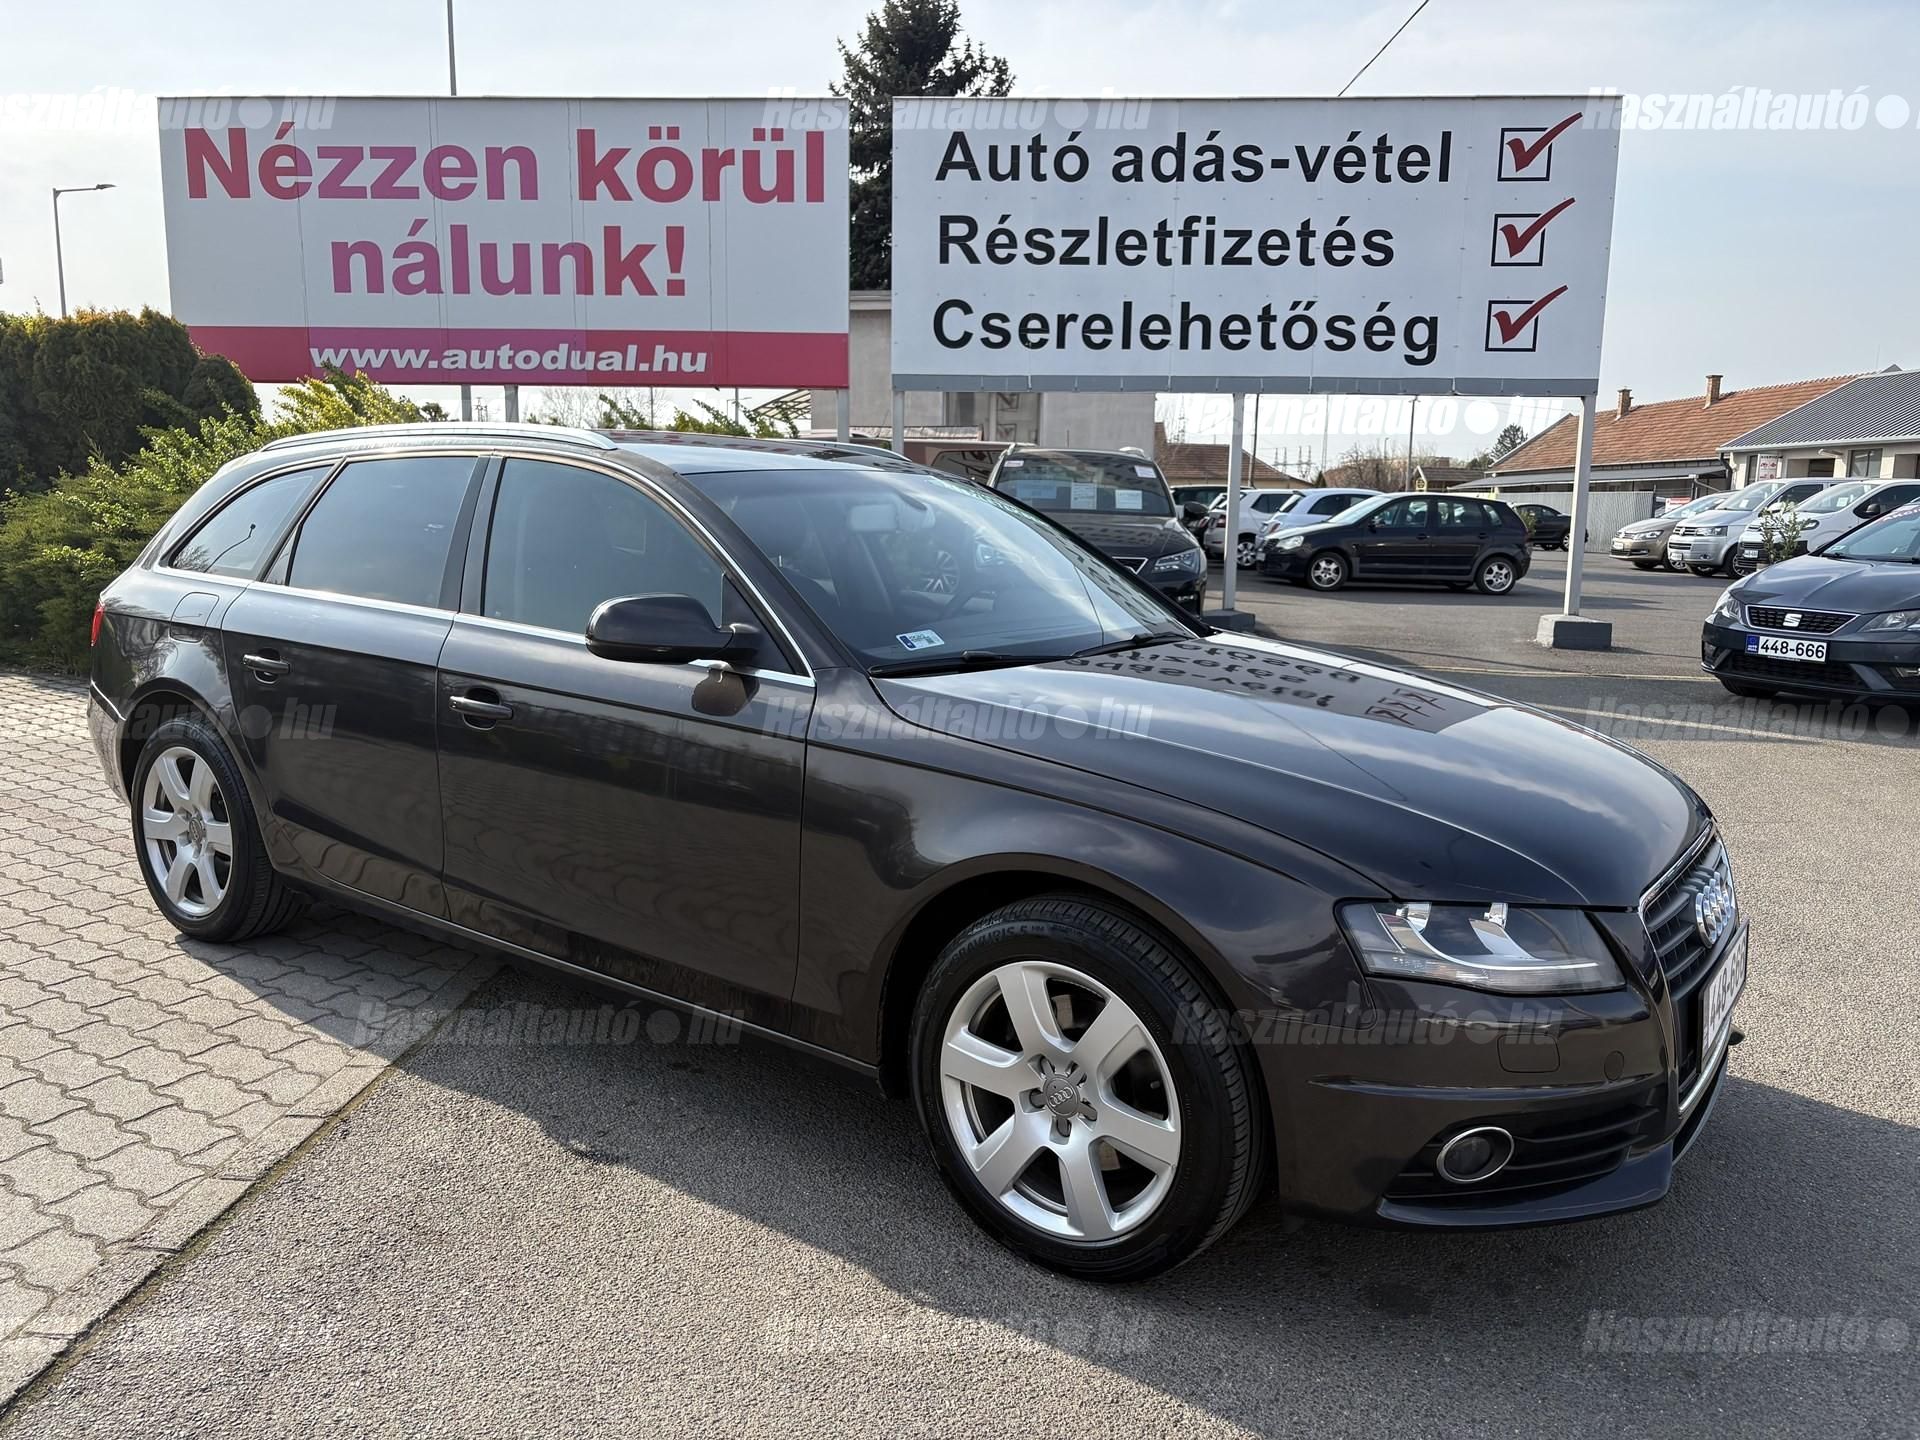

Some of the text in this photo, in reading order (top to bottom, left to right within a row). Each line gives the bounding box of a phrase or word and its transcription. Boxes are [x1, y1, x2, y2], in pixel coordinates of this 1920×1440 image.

[184, 121, 825, 203] Nézzen körül
[935, 129, 1452, 184] Autó adás-vétel
[330, 218, 686, 297] nálunk!
[939, 213, 1395, 268] Részletfizetés
[309, 343, 707, 374] www.autodual.hu
[933, 298, 1440, 366] Cserelehetőség
[1760, 639, 1825, 659] 448-666
